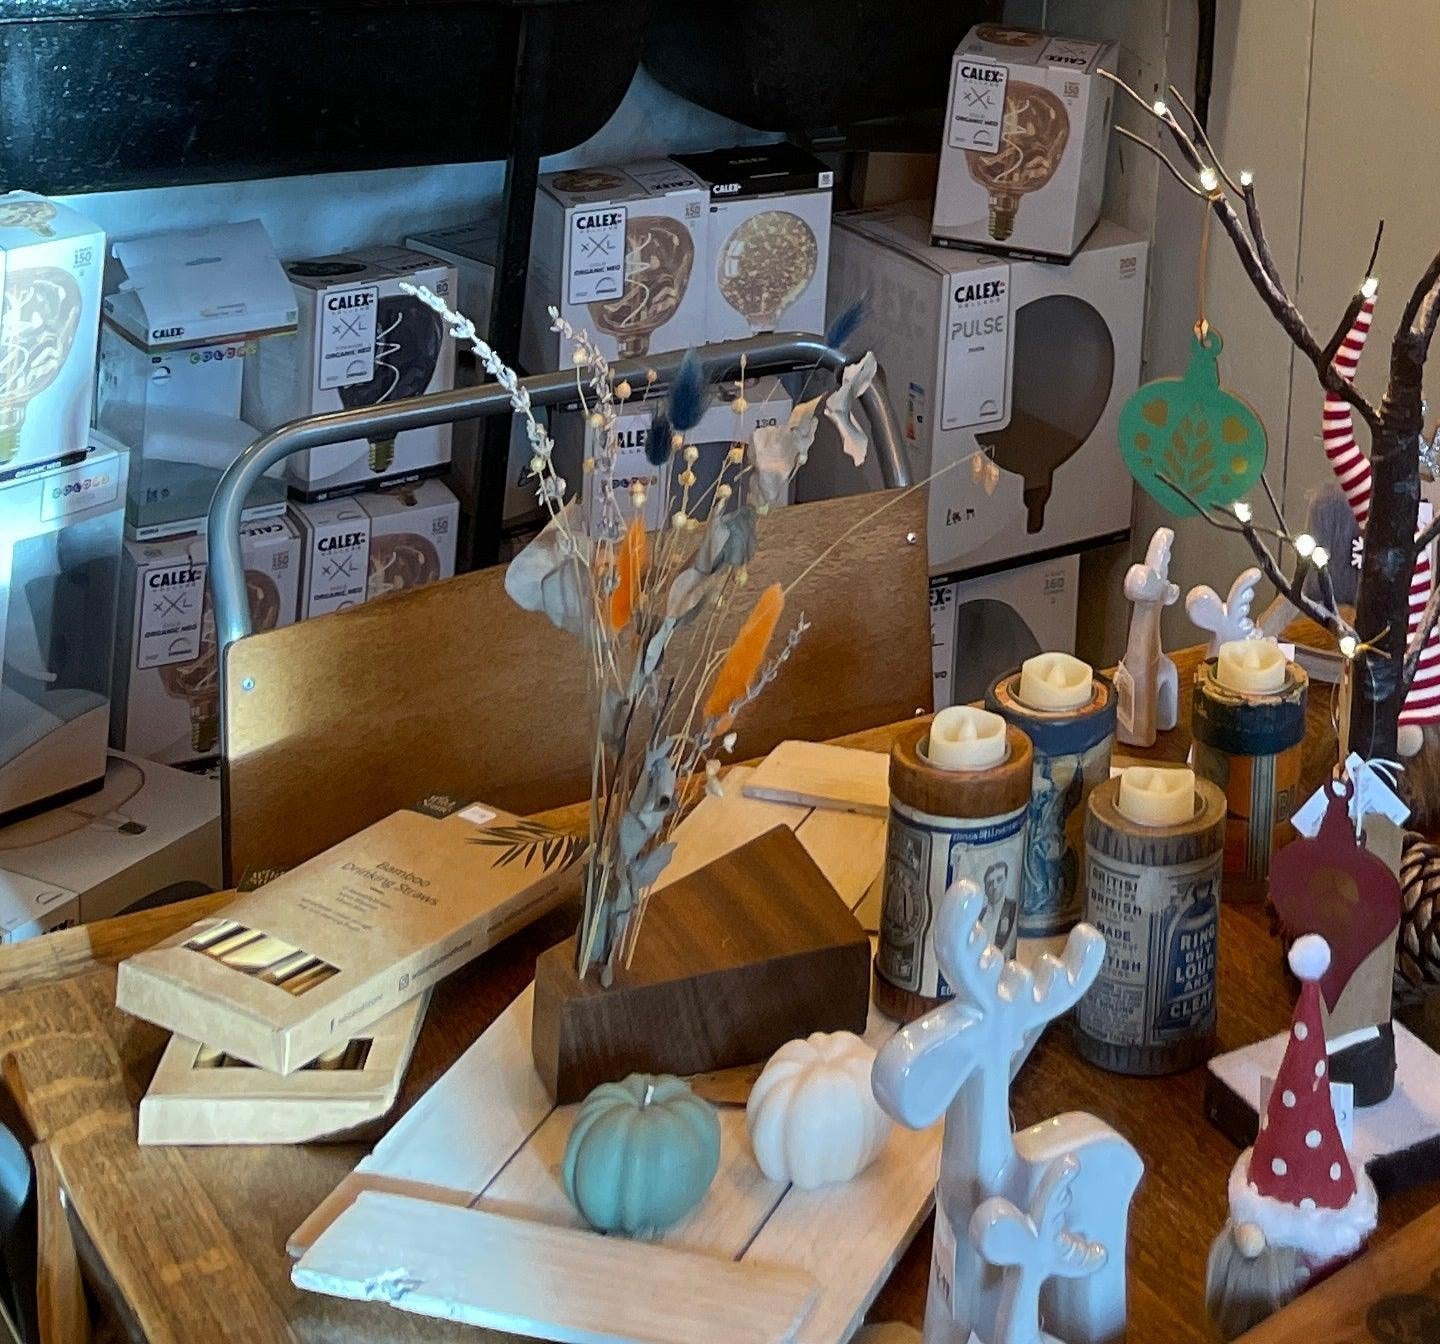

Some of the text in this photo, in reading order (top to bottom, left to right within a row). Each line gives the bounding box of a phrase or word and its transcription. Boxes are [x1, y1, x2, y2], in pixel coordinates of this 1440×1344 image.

[961, 66, 1000, 82] CALEX
[576, 213, 618, 230] CALEX
[74, 251, 92, 265] 150
[954, 280, 1000, 303] CALEX
[328, 293, 370, 311] CALEX
[152, 327, 182, 340] CALEX
[952, 315, 1004, 340] PULSE
[755, 418, 777, 429] 130
[318, 532, 362, 552] CALEX
[150, 569, 196, 588] CALEX
[376, 862, 431, 887] Bamboo
[341, 862, 396, 889] Drinking
[397, 881, 440, 907] Straws
[1091, 889, 1142, 916] BRITISH
